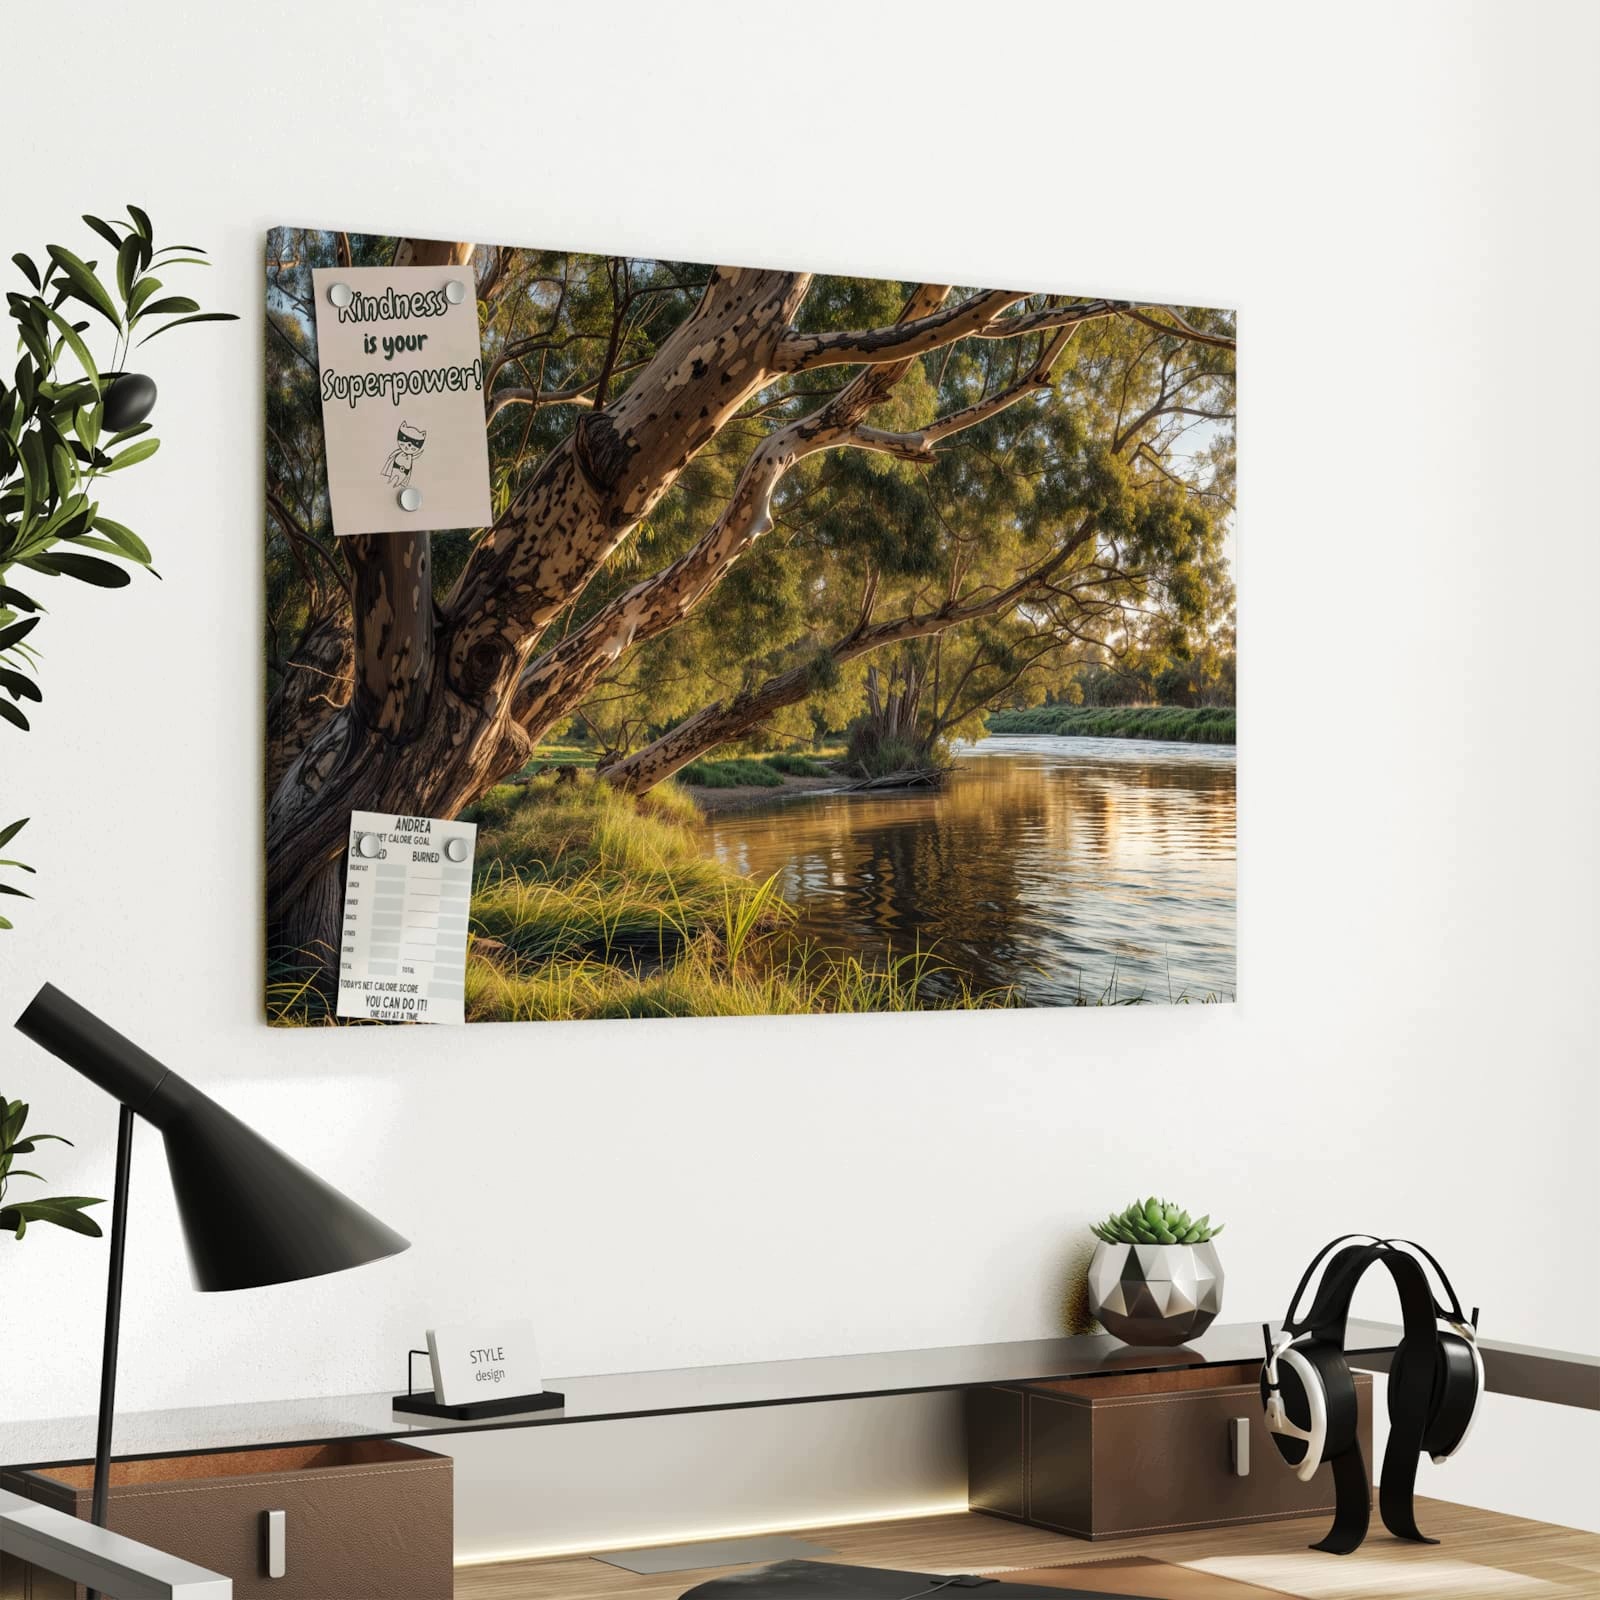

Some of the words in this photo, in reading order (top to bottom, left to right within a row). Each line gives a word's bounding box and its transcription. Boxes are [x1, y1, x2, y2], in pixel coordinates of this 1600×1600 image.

[338, 287, 449, 323] Kindness
[364, 333, 377, 354] is
[382, 333, 428, 361] your
[322, 359, 482, 408] Superpower!
[395, 817, 431, 834] ANDREA
[388, 834, 413, 845] CALORIE
[413, 837, 430, 846] GOAL
[412, 851, 440, 863] BURNED
[363, 981, 373, 990] NET
[375, 982, 398, 992] CALORIE
[399, 983, 419, 994] SCORE
[366, 995, 381, 1008] YOU
[383, 996, 400, 1009] CAN
[402, 998, 415, 1010] DO
[417, 999, 428, 1011] IT!
[370, 1009, 380, 1018] ONE
[380, 1010, 391, 1019] DAY
[406, 1012, 418, 1021] TIME
[470, 1347, 505, 1365] STYLE
[475, 1369, 506, 1383] design
